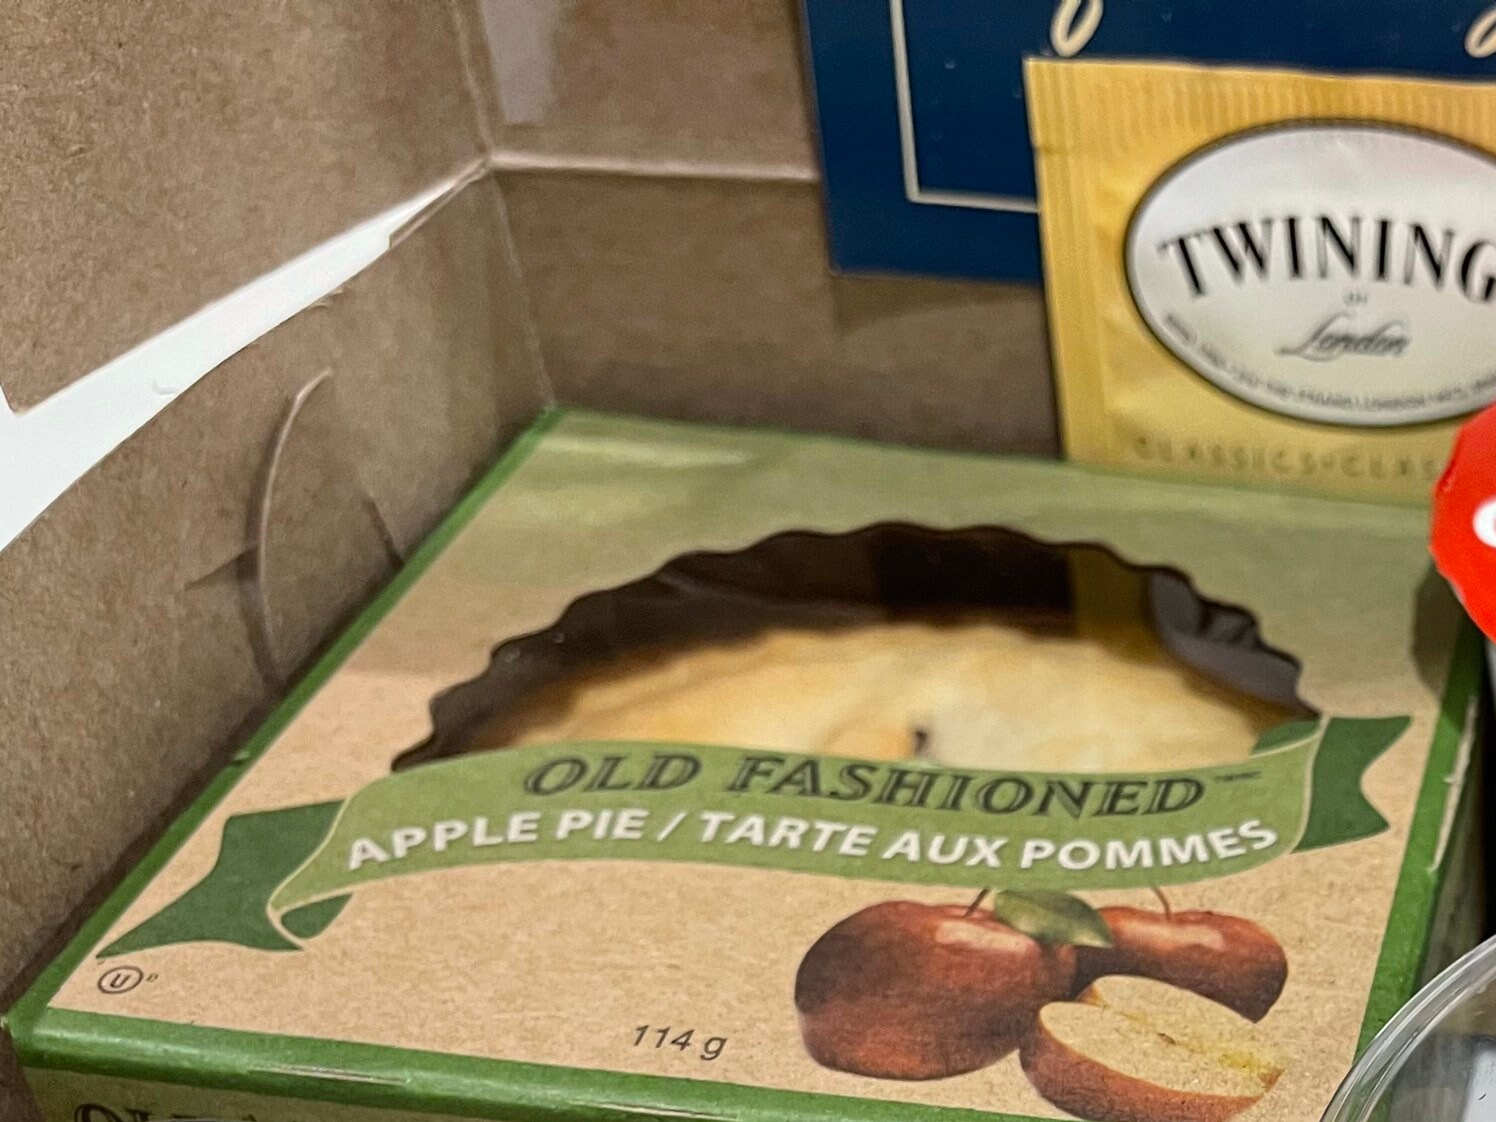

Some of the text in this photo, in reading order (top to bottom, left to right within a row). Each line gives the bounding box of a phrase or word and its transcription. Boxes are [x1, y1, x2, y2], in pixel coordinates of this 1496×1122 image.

[1274, 311, 1411, 361] London
[523, 752, 1206, 821] OLD FASHIONED
[347, 811, 542, 871] APPLE
[555, 808, 650, 841] PIE
[699, 811, 879, 857] TARTE
[882, 830, 1009, 869] AUX
[1019, 818, 1280, 871] POMMES
[634, 1024, 728, 1061] 114 g
